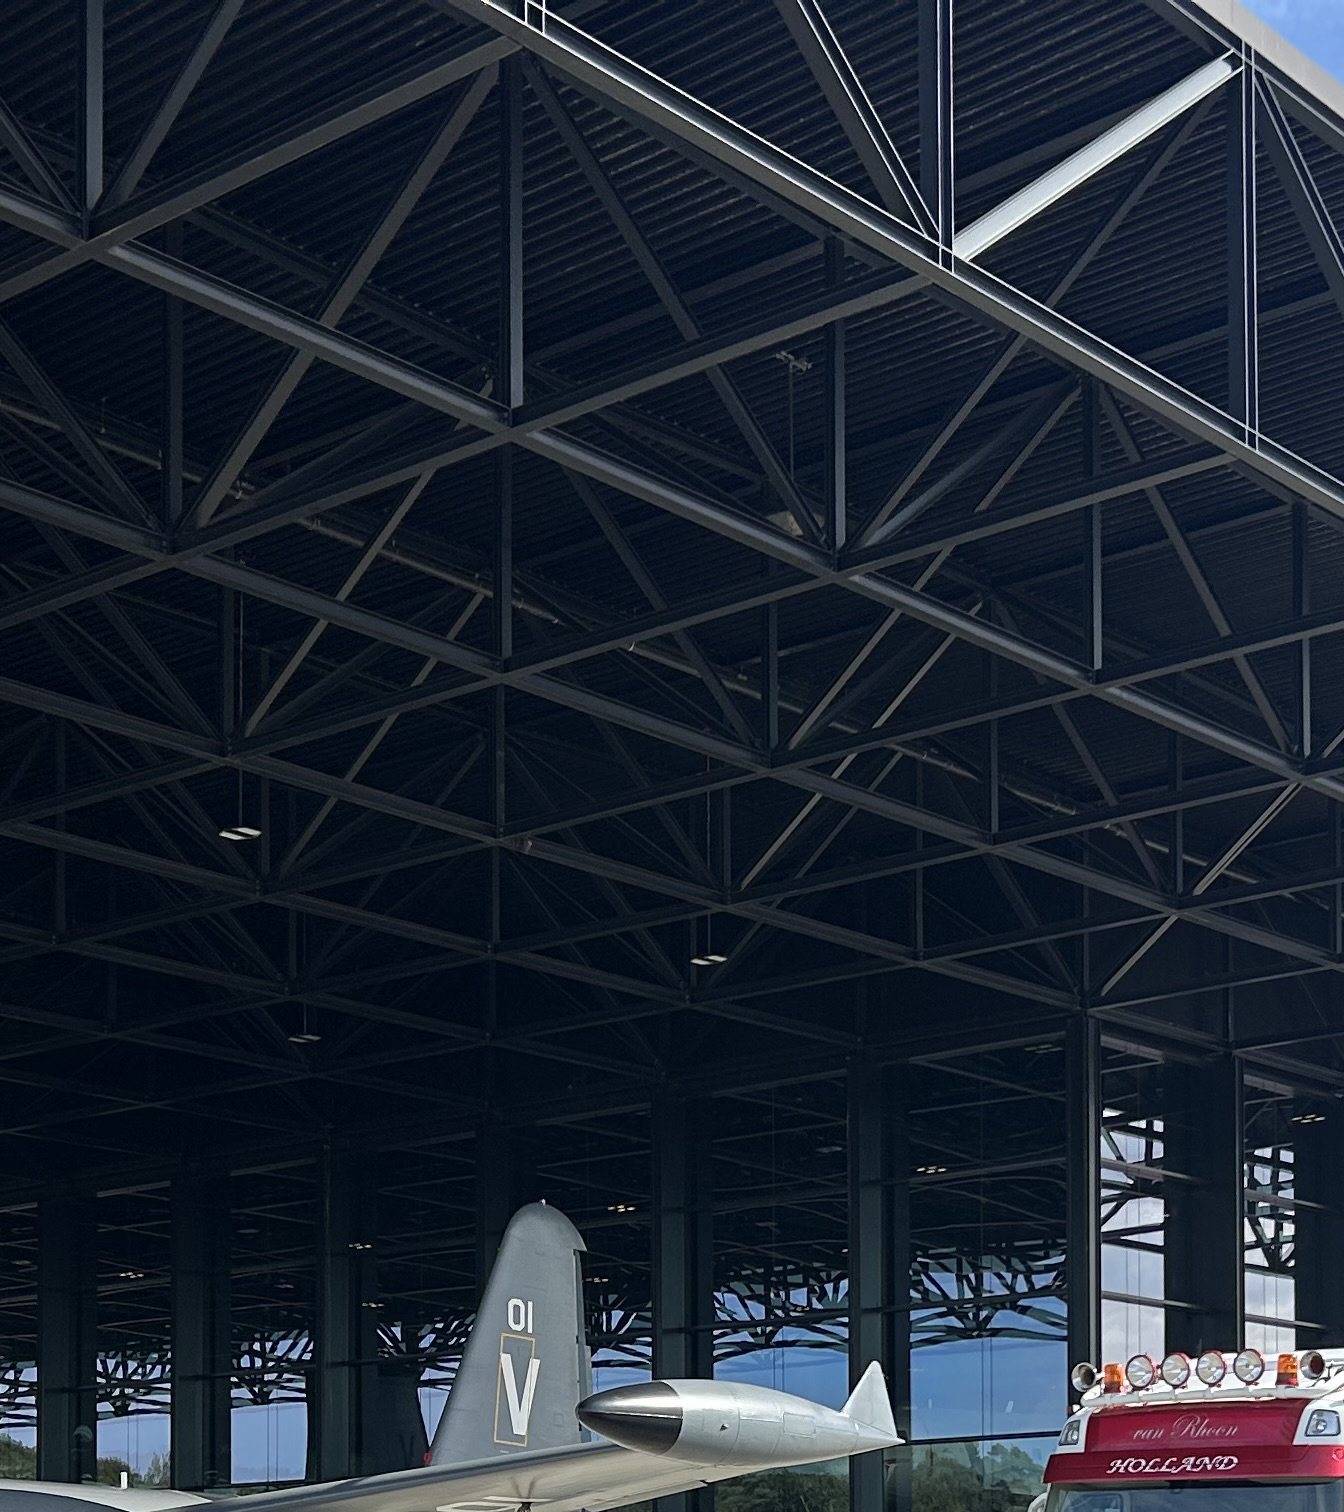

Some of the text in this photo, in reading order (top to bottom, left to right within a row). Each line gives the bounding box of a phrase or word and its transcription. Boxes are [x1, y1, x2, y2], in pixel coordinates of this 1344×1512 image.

[507, 1298, 533, 1334] 01
[500, 1353, 541, 1436] V
[1106, 1456, 1239, 1474] HOLLAND
